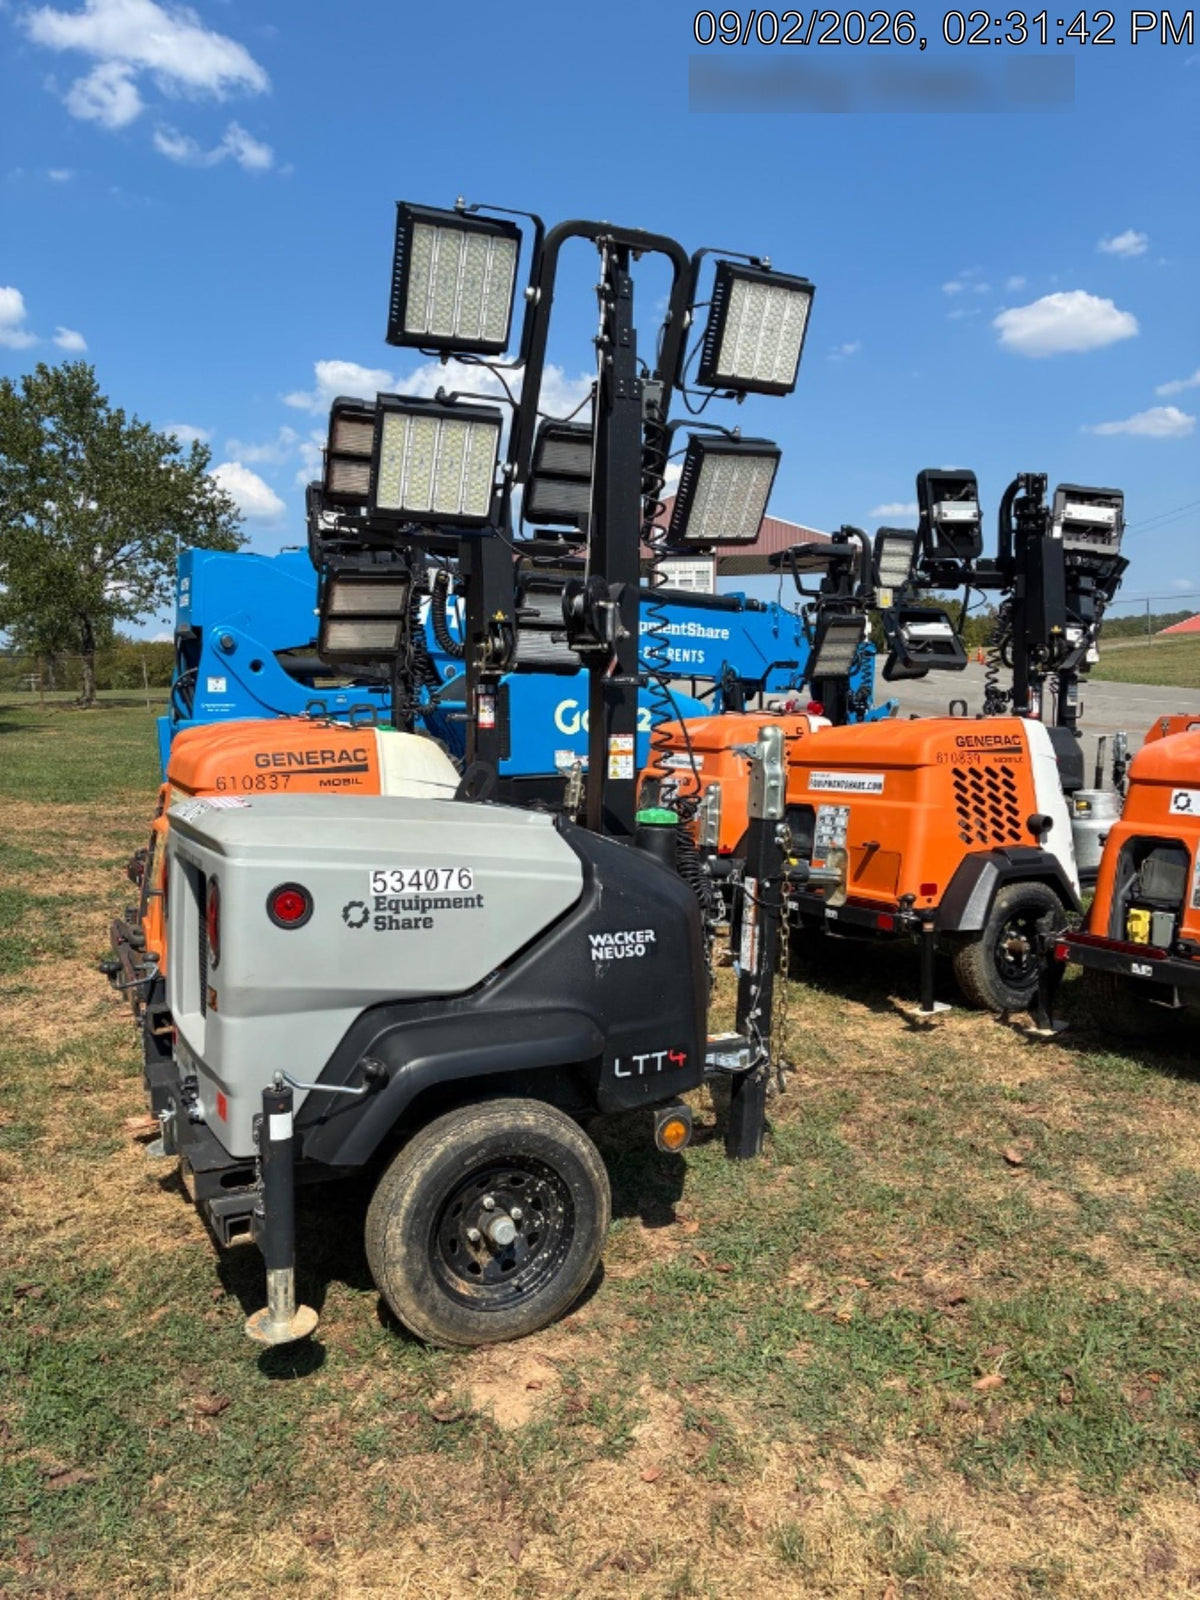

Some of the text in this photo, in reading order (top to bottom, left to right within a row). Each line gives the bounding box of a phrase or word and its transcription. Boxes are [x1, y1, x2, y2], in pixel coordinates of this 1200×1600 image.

[638, 621, 730, 640] pmentShare
[955, 734, 1022, 748] GENERAC
[254, 748, 369, 769] GENERAC
[216, 774, 291, 791] 610837
[372, 867, 472, 893] 534076
[373, 894, 485, 914] Equipment
[373, 915, 434, 932] Share
[588, 929, 657, 947] WACKER
[591, 943, 646, 961] NEUSO
